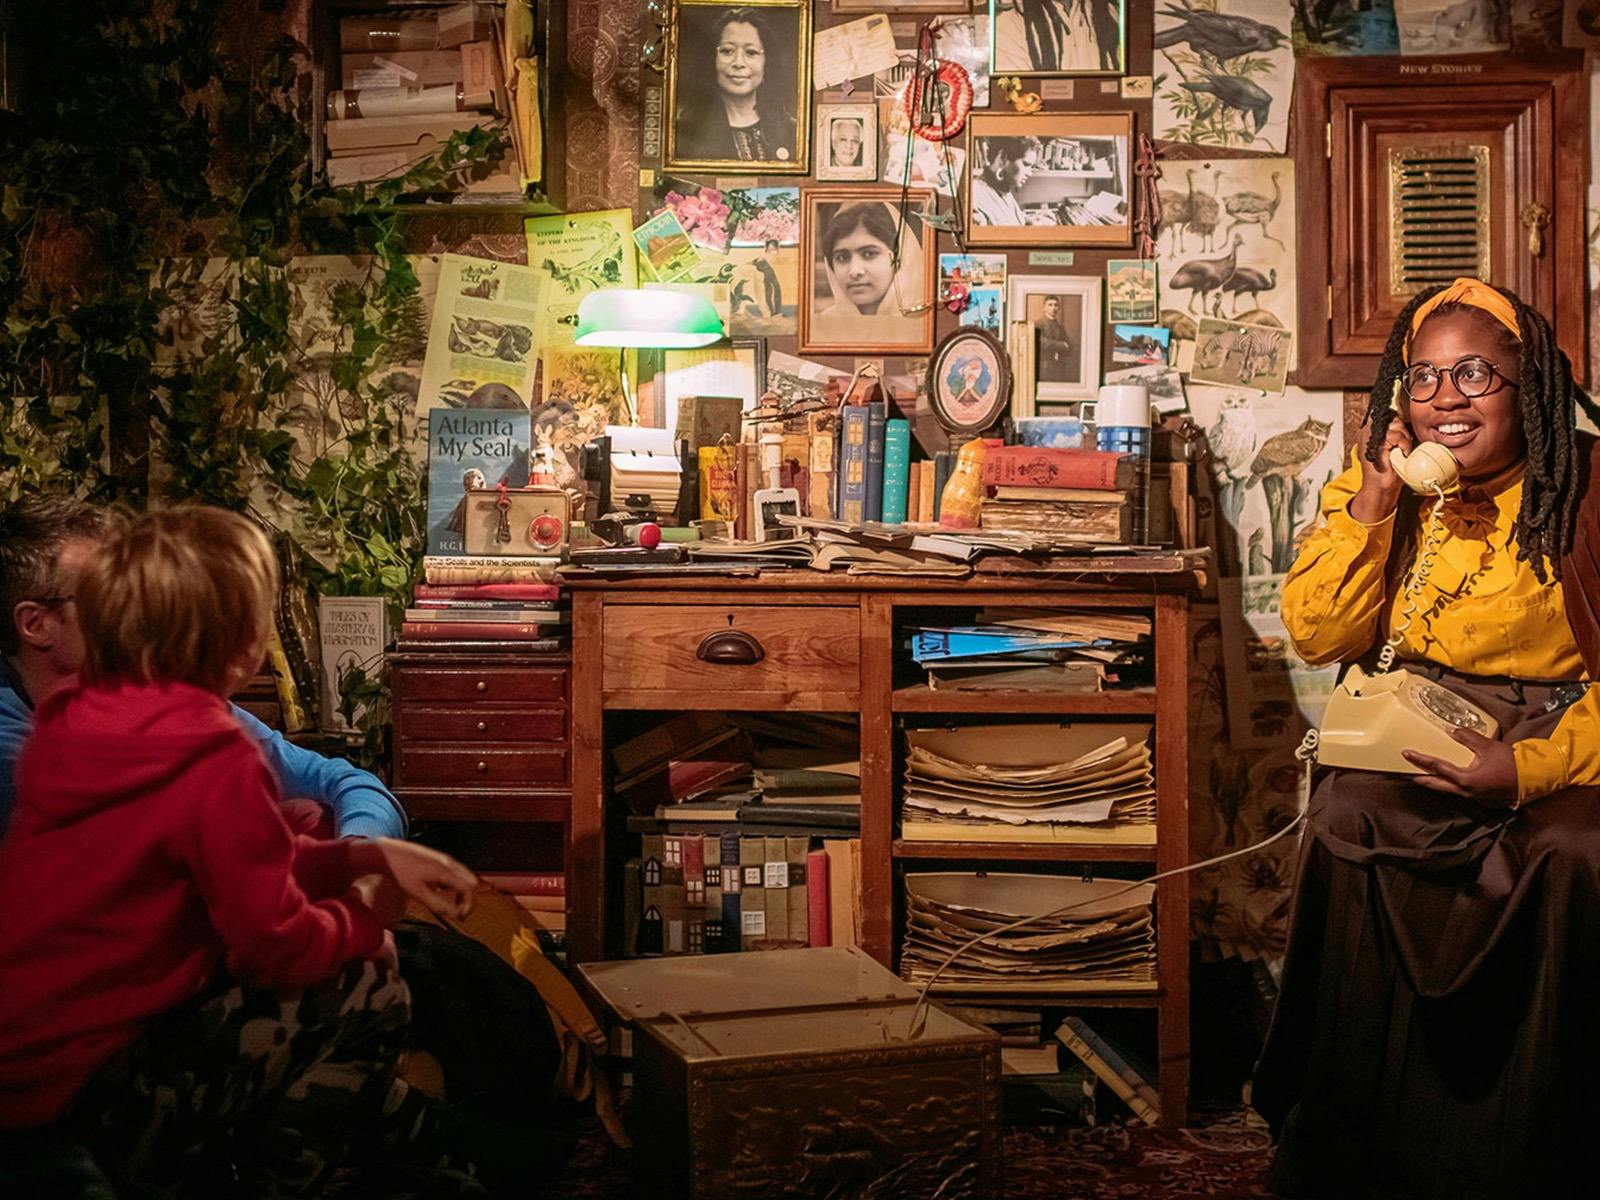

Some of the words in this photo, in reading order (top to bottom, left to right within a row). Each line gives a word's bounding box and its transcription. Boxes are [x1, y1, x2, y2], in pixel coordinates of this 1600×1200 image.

[437, 415, 513, 436] Atlanta
[438, 437, 467, 461] My
[472, 437, 511, 457] Seal
[469, 558, 484, 567] and
[486, 558, 500, 567] the
[501, 558, 541, 568] Scientists
